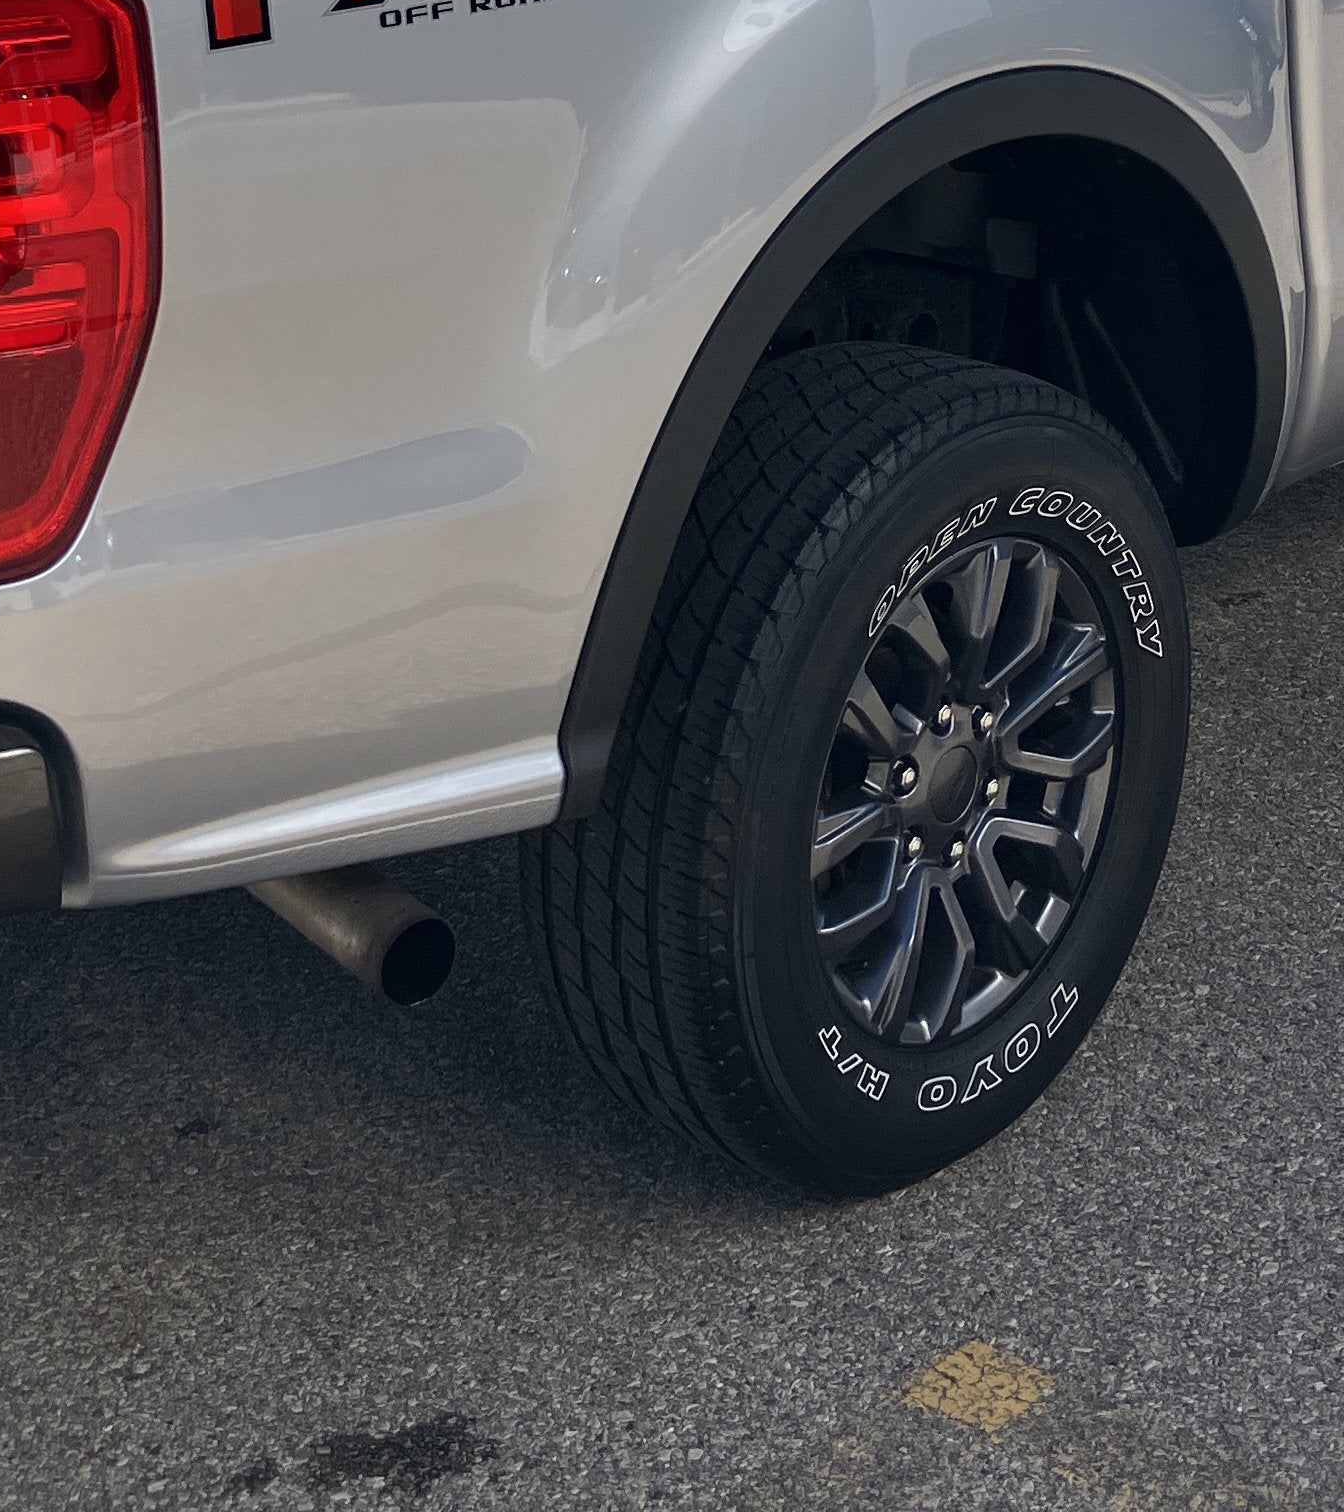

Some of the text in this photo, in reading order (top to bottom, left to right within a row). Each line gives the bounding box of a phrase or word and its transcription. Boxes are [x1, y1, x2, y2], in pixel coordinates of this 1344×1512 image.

[379, 0, 454, 29] OFF
[868, 486, 1164, 658] OPEN COUNTRY
[817, 982, 1080, 1112] TOYO H/T
